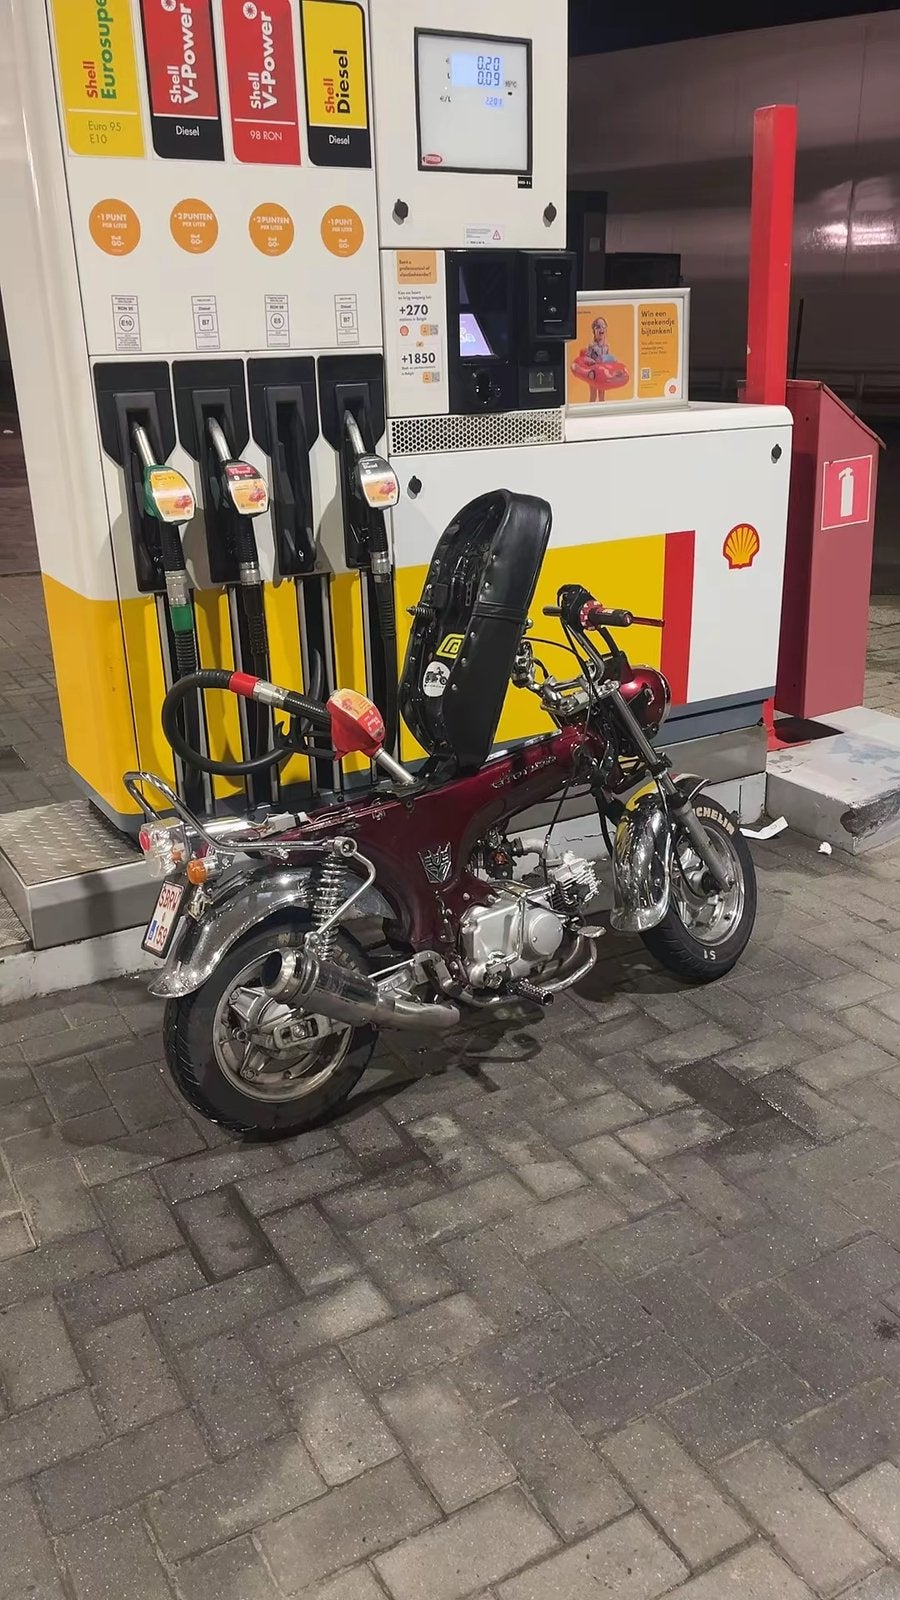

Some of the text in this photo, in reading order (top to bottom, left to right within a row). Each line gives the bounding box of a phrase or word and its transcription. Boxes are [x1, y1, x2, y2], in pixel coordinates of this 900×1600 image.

[180, 4, 199, 103] V-Power
[261, 11, 277, 109] V-Power
[83, 61, 98, 98] Shell
[167, 65, 181, 104] Shell
[333, 50, 351, 114] Diesel
[248, 72, 261, 109] Shell
[323, 78, 335, 114] Shell
[88, 120, 121, 131] Euro 95
[175, 125, 200, 137] Diesel
[250, 130, 283, 141] 98 RON
[90, 134, 108, 144] E10
[328, 134, 350, 145] Diesel
[399, 304, 429, 316] +270
[641, 318, 675, 327] weekendje
[401, 352, 436, 364] +1850
[692, 806, 735, 836] ICHELIN
